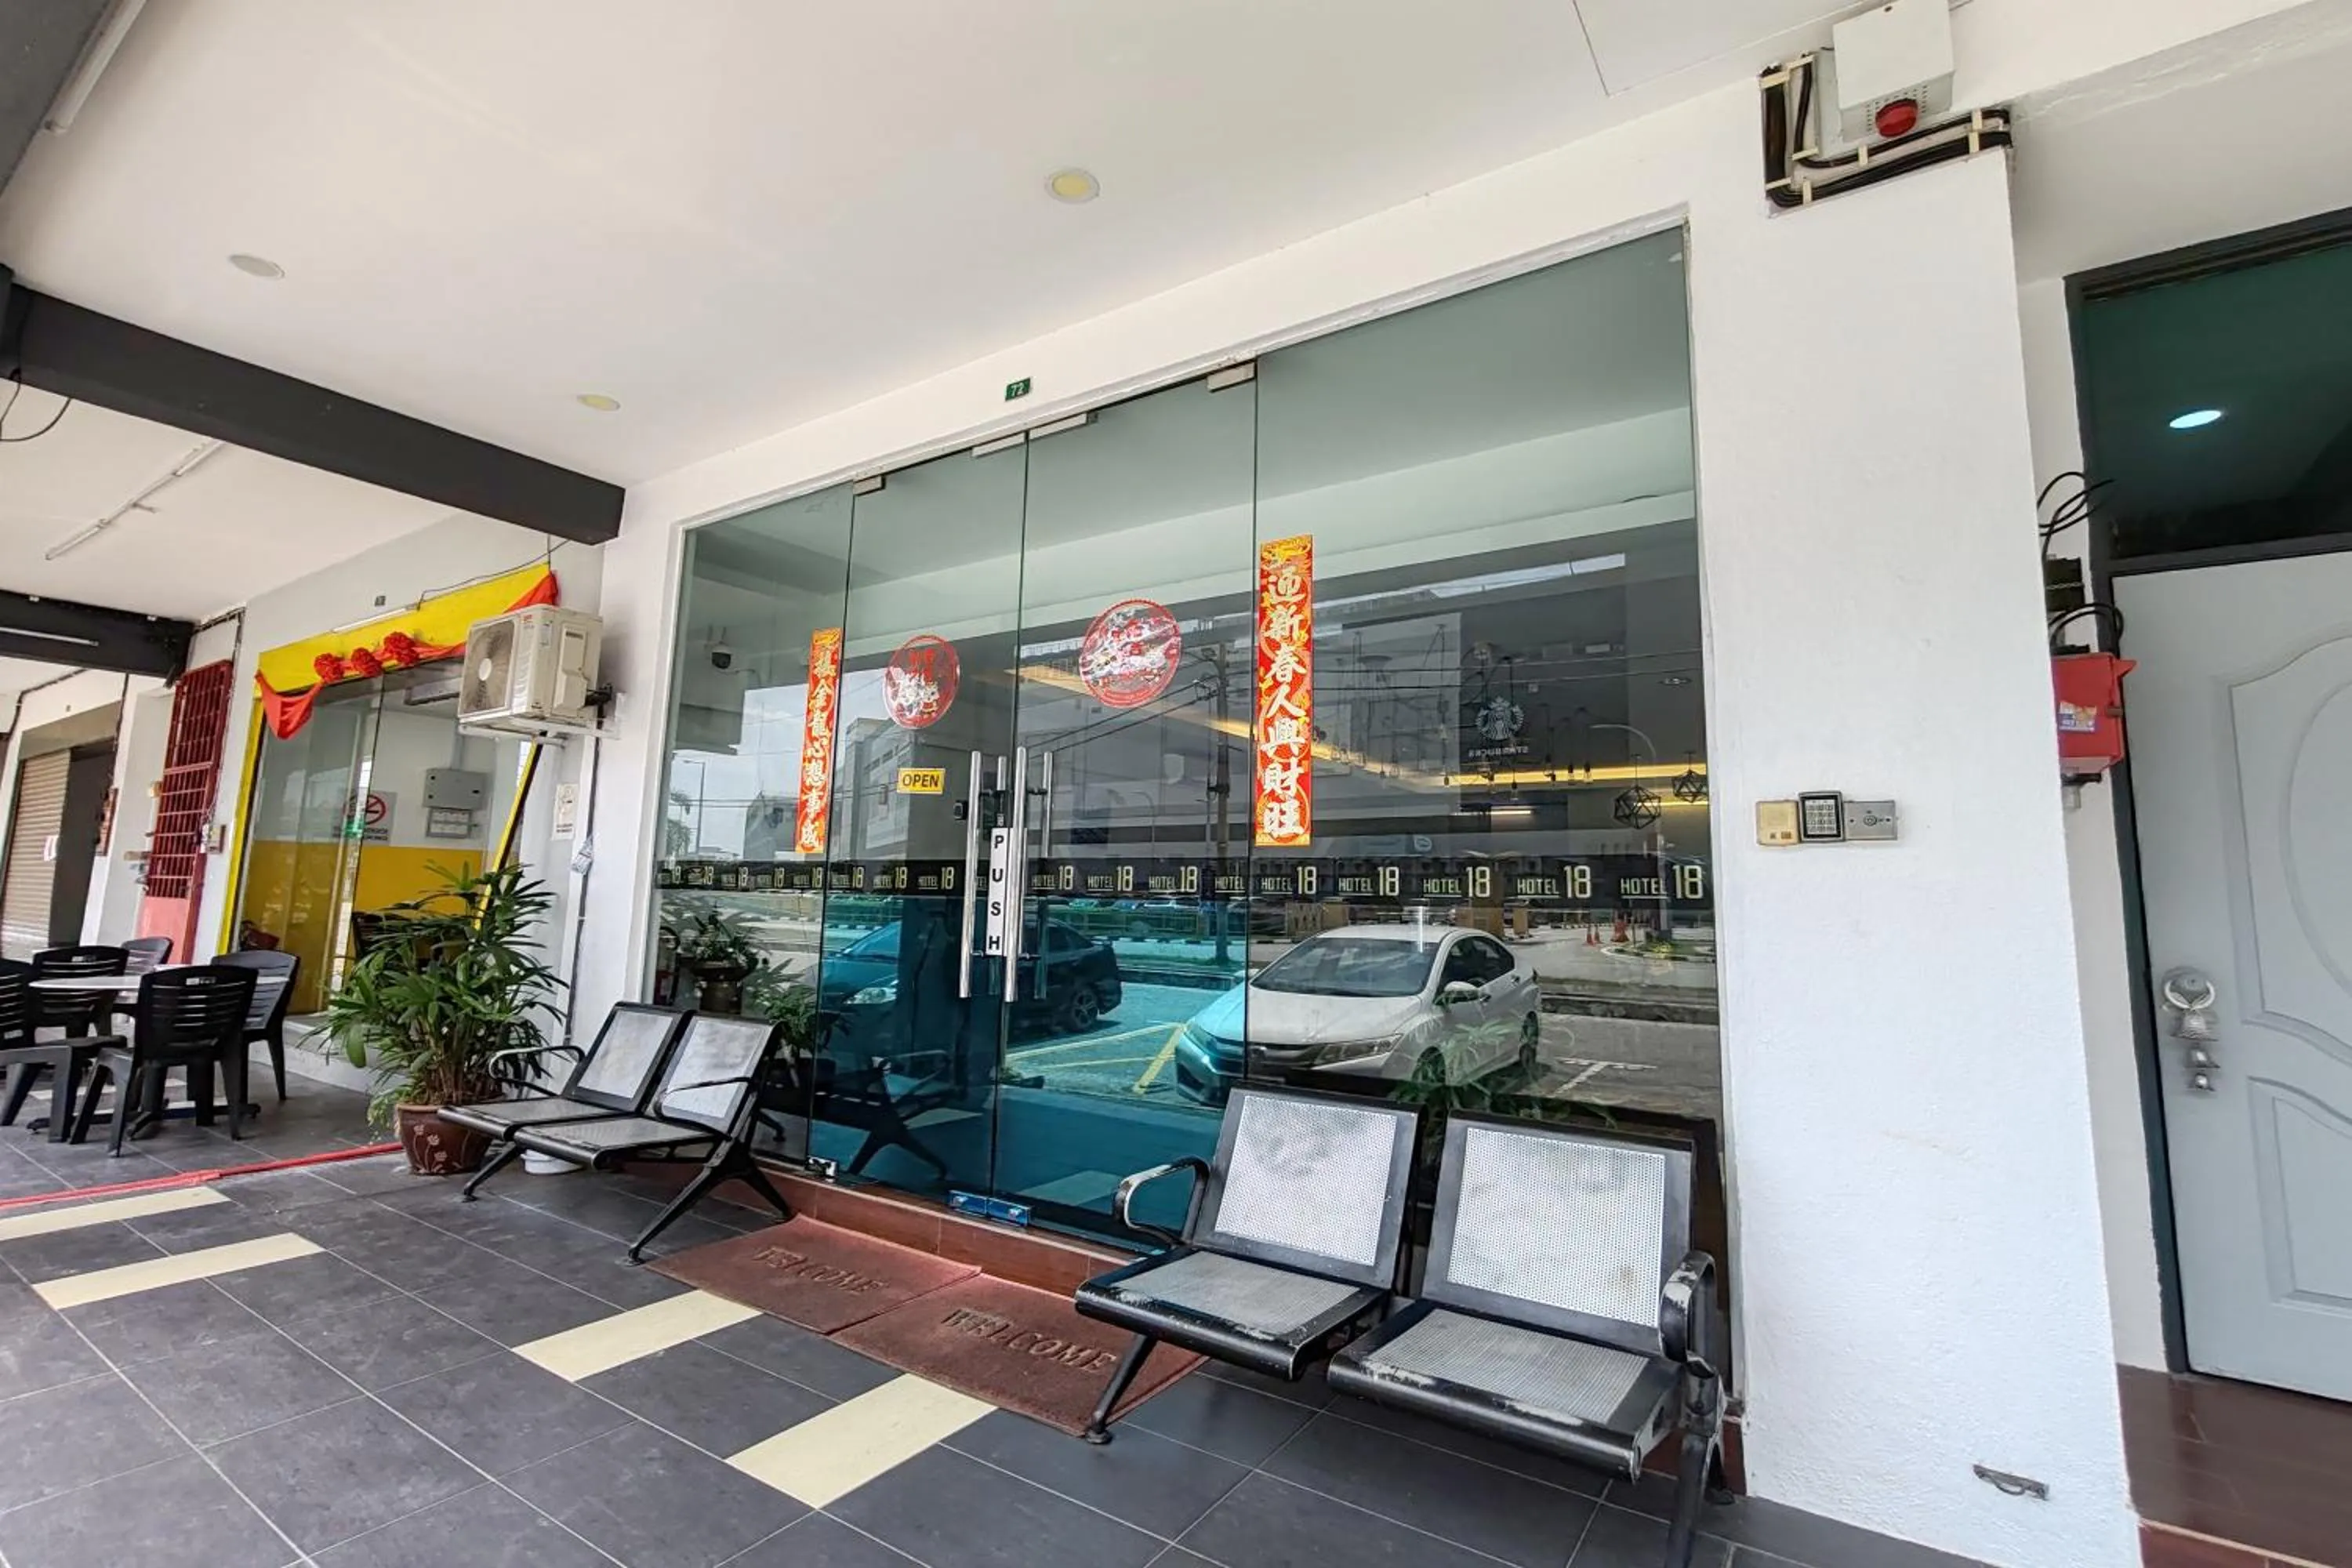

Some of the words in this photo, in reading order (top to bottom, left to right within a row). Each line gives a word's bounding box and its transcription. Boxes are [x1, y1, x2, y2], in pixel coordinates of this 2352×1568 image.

[1011, 382, 1024, 396] 72
[1261, 564, 1308, 837] 迎新春人興財旺
[902, 773, 940, 788] OPEN
[852, 866, 864, 888] 18
[895, 866, 907, 889] 18
[941, 866, 954, 890] 18
[1032, 875, 1055, 887] HOTEL
[1058, 866, 1073, 891] 18
[1087, 876, 1113, 888] HOTEL
[1116, 866, 1134, 891] 18
[1149, 876, 1176, 889] HOTEL
[1180, 866, 1197, 893] 18
[1215, 876, 1245, 890] HOTEL
[1261, 877, 1293, 891] HOTEL
[1297, 866, 1317, 895] 18
[1338, 877, 1373, 892] HOTEL
[1377, 866, 1399, 896] 18
[1423, 878, 1461, 893] HOTEL
[1466, 866, 1490, 898] 18
[1517, 878, 1559, 895] HOTEL
[1564, 866, 1592, 898] 18
[1621, 878, 1668, 895] HOTEL
[1672, 865, 1704, 899] 18
[988, 835, 1004, 950] PUSH
[941, 1308, 1117, 1373] WELCOME
